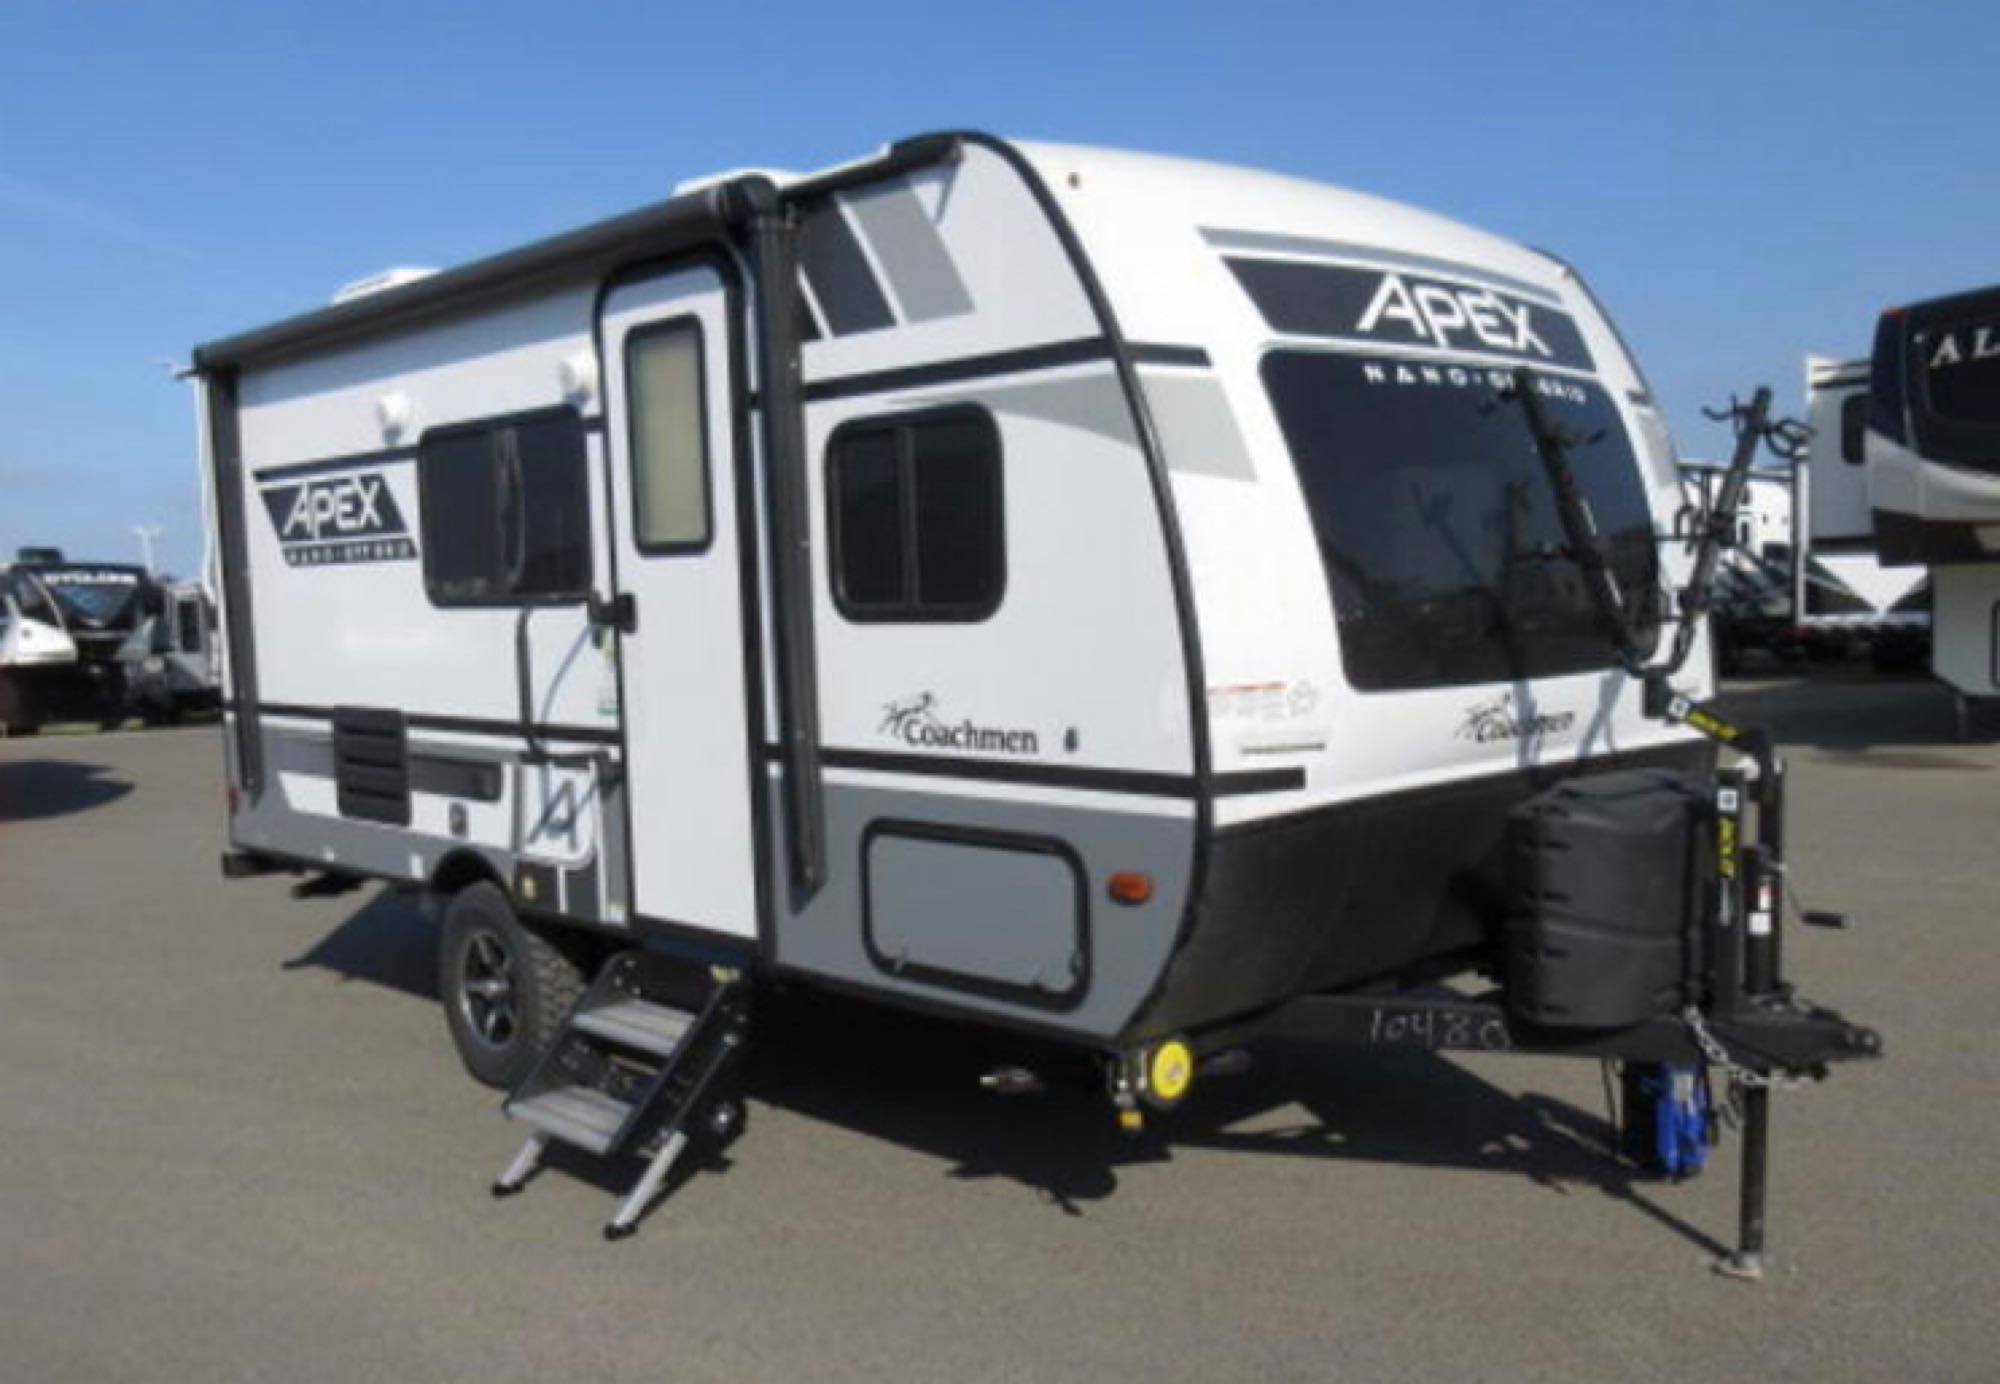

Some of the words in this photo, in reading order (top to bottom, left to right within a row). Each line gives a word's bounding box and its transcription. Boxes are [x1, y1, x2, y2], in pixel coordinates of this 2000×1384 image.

[1357, 272, 1552, 356] APEX
[283, 474, 382, 541] APEX
[903, 718, 1039, 753] Coachmen
